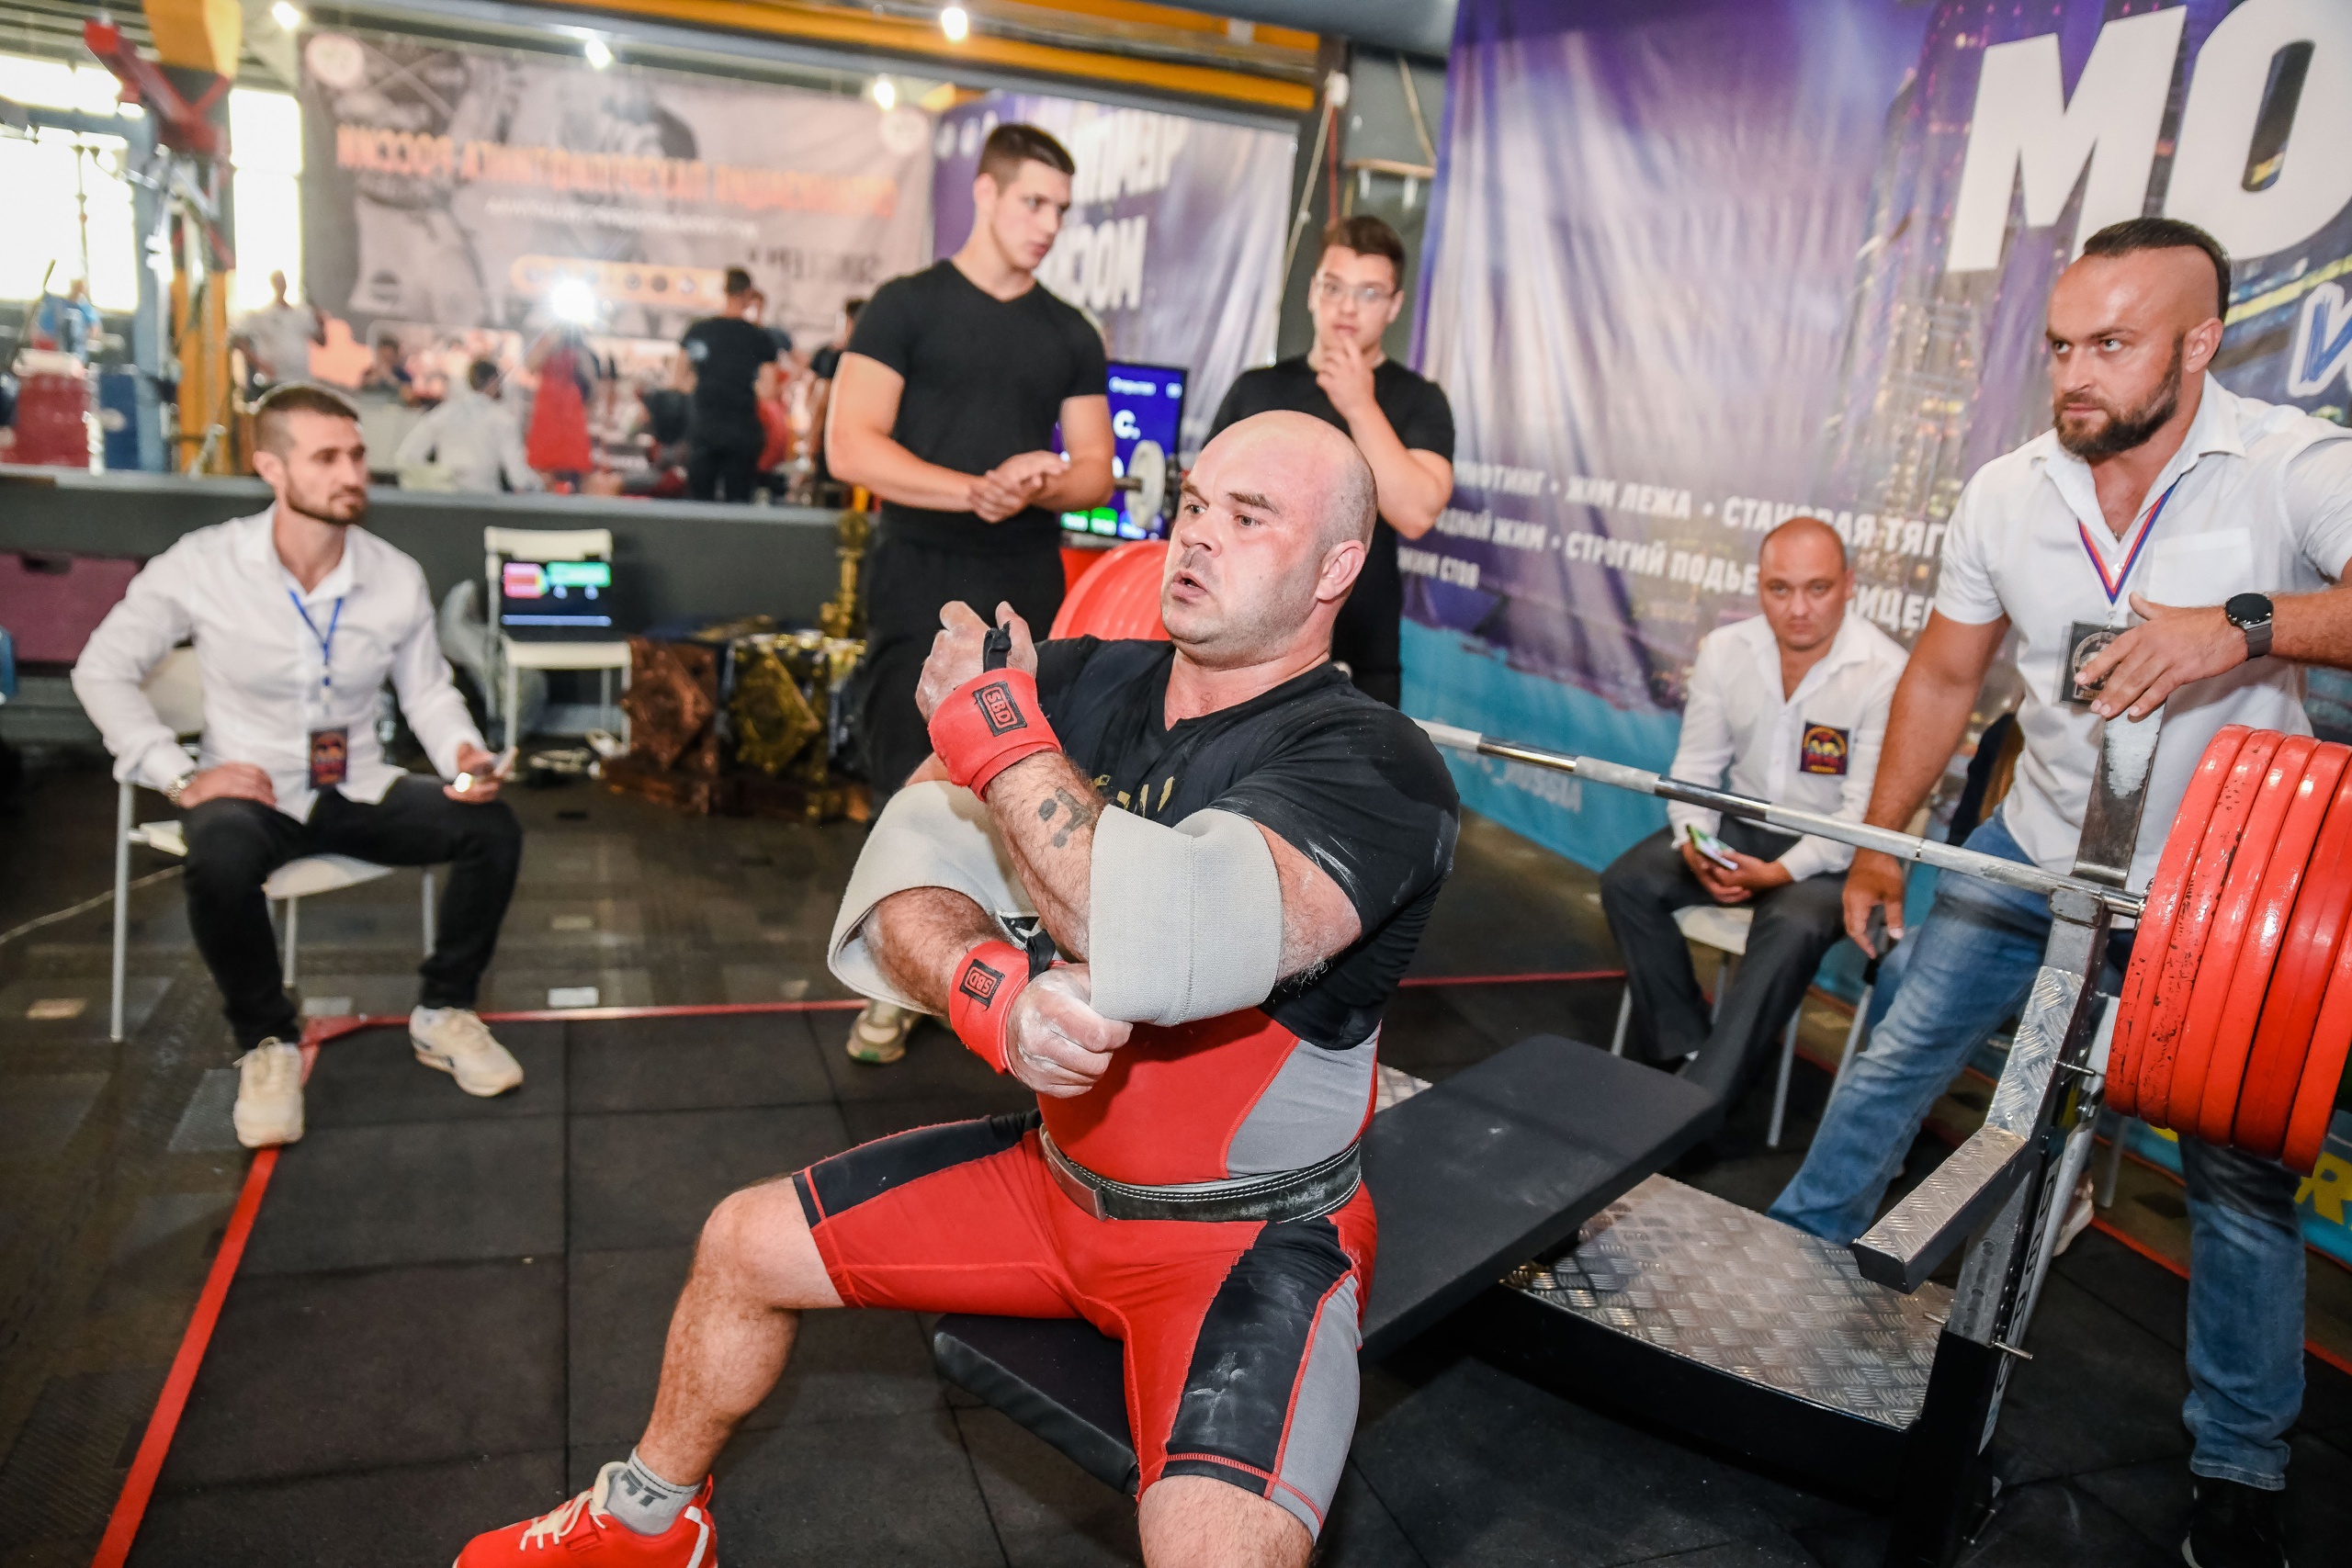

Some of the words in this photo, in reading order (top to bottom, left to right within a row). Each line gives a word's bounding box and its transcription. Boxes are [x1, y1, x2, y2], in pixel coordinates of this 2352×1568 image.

[1617, 481, 1692, 520] ЛЕЖА
[1566, 530, 1668, 578] СТРОГИЙ
[986, 691, 1012, 723] SBD
[969, 971, 993, 994] SBD
